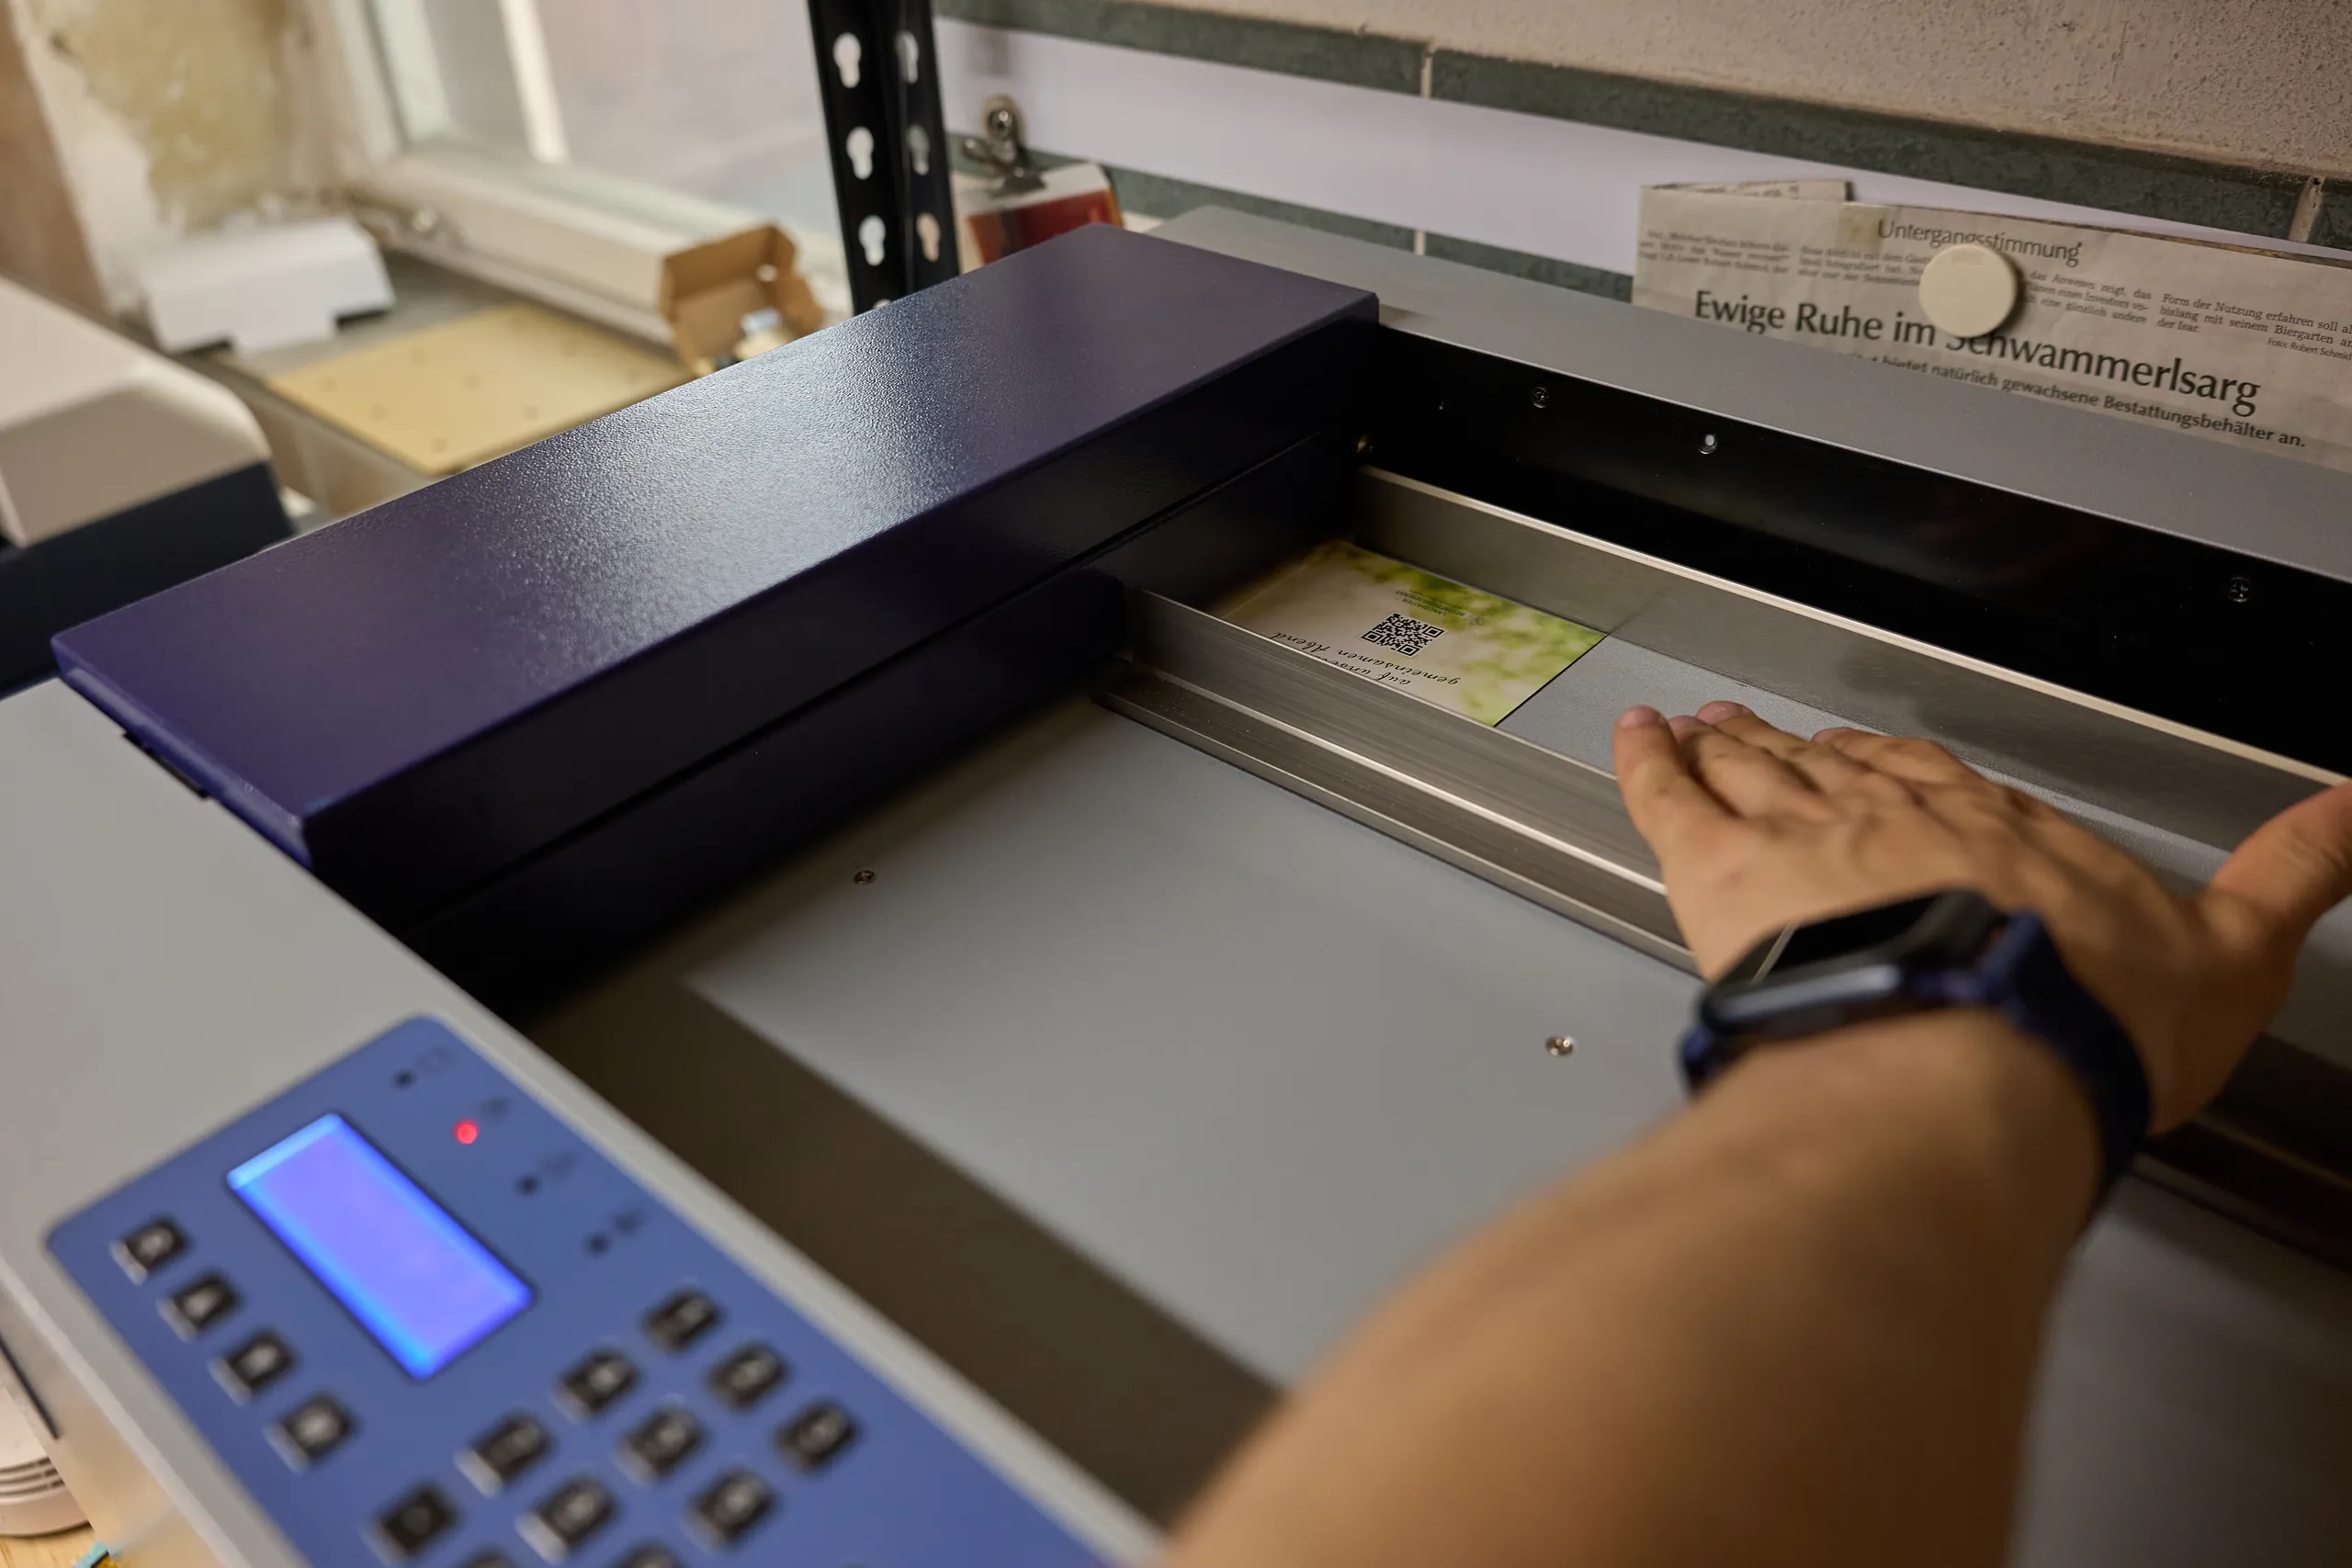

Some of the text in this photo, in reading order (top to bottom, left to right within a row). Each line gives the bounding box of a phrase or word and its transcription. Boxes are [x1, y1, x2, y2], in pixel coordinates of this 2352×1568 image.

[1877, 219, 2083, 268] Untergangsstimmung
[1695, 289, 1786, 335] Ewige
[1795, 302, 1884, 342] Ruhe
[1893, 310, 1937, 347] im
[2157, 317, 2176, 329] der
[2159, 305, 2199, 322] bislang
[2204, 314, 2223, 325] mit
[2229, 318, 2268, 333] seinem
[2274, 324, 2334, 344] Biergarten
[2161, 293, 2189, 308] Form
[2193, 298, 2211, 310] der
[2214, 301, 2263, 321] Nutzung
[2266, 311, 2314, 328] erfahren
[2317, 321, 2338, 332] soll
[2290, 342, 2318, 355] Robert
[1931, 365, 1998, 388] natürlich
[2002, 378, 2099, 407] gewachsene
[2103, 394, 2275, 441] Bestattungsbehälter
[2278, 432, 2307, 448] an.
[1268, 632, 1461, 685] gemeinsamen Abend
[1377, 671, 1411, 685] auf
